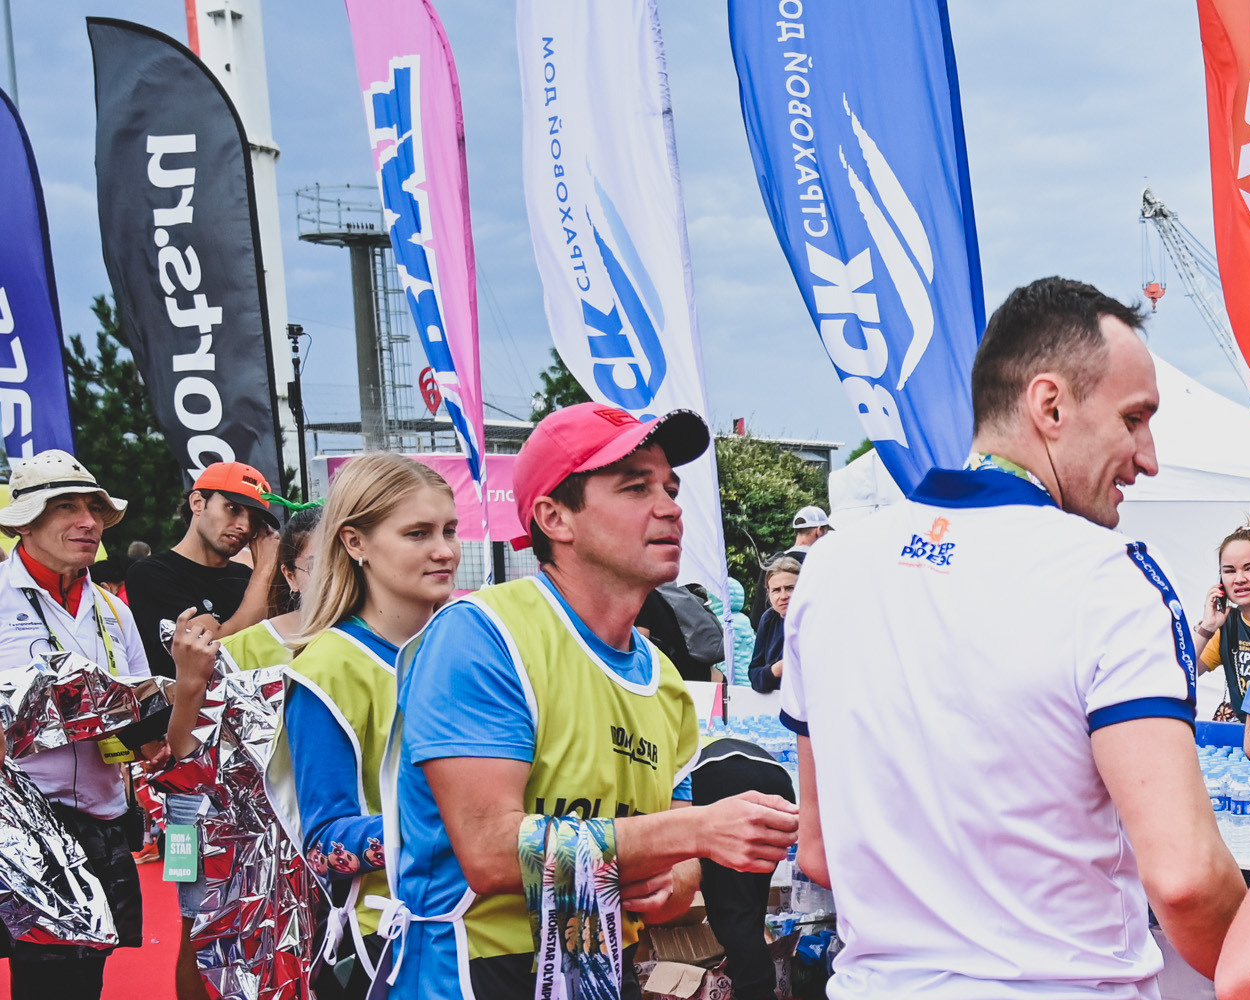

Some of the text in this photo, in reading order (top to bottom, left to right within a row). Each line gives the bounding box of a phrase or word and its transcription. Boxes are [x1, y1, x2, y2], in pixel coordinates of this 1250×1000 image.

[1175, 621, 1197, 688] ОРТО-СПОРТ
[168, 868, 192, 877] ВИДЕО
[170, 843, 192, 854] STAR
[545, 909, 558, 961] IRONSTAR
[605, 912, 619, 962] IRONSTAR
